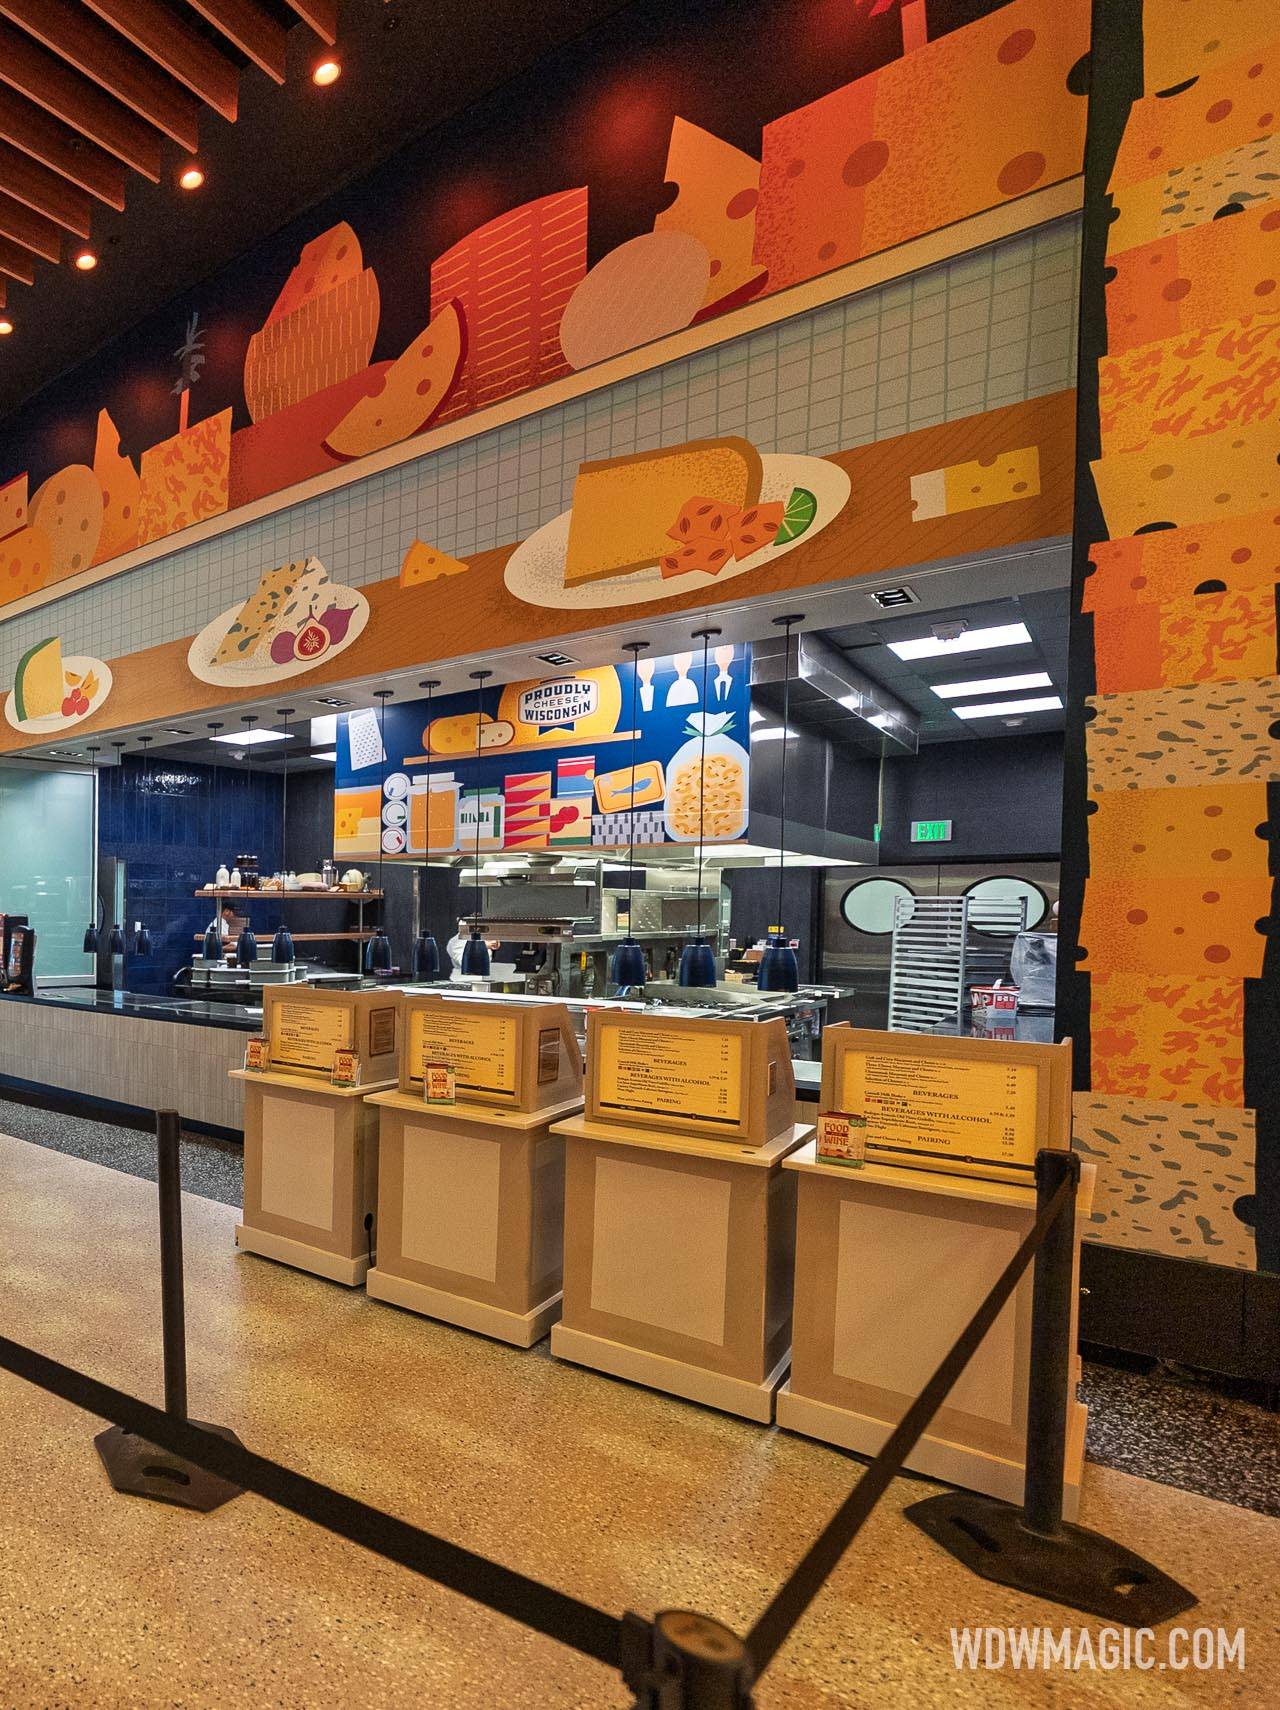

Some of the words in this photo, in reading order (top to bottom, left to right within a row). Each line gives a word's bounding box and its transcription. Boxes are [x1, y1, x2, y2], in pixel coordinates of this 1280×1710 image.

[525, 684, 591, 704] PROUDLY
[534, 695, 579, 708] CHEESE
[525, 700, 591, 720] WISCONSIN
[917, 823, 945, 840] EXIT
[653, 1058, 687, 1067] BEVERAGES
[630, 1073, 663, 1081] BEVERAGES
[681, 1078, 710, 1086] ALCOHOL
[913, 1090, 959, 1100] BEVERAGES
[881, 1106, 926, 1115] BEVERAGES
[926, 1111, 951, 1119] WITH
[951, 1113, 992, 1124] ALCOHOL
[825, 1122, 849, 1132] FOOD
[824, 1135, 849, 1146] WINE
[918, 1135, 951, 1145] PAIRING
